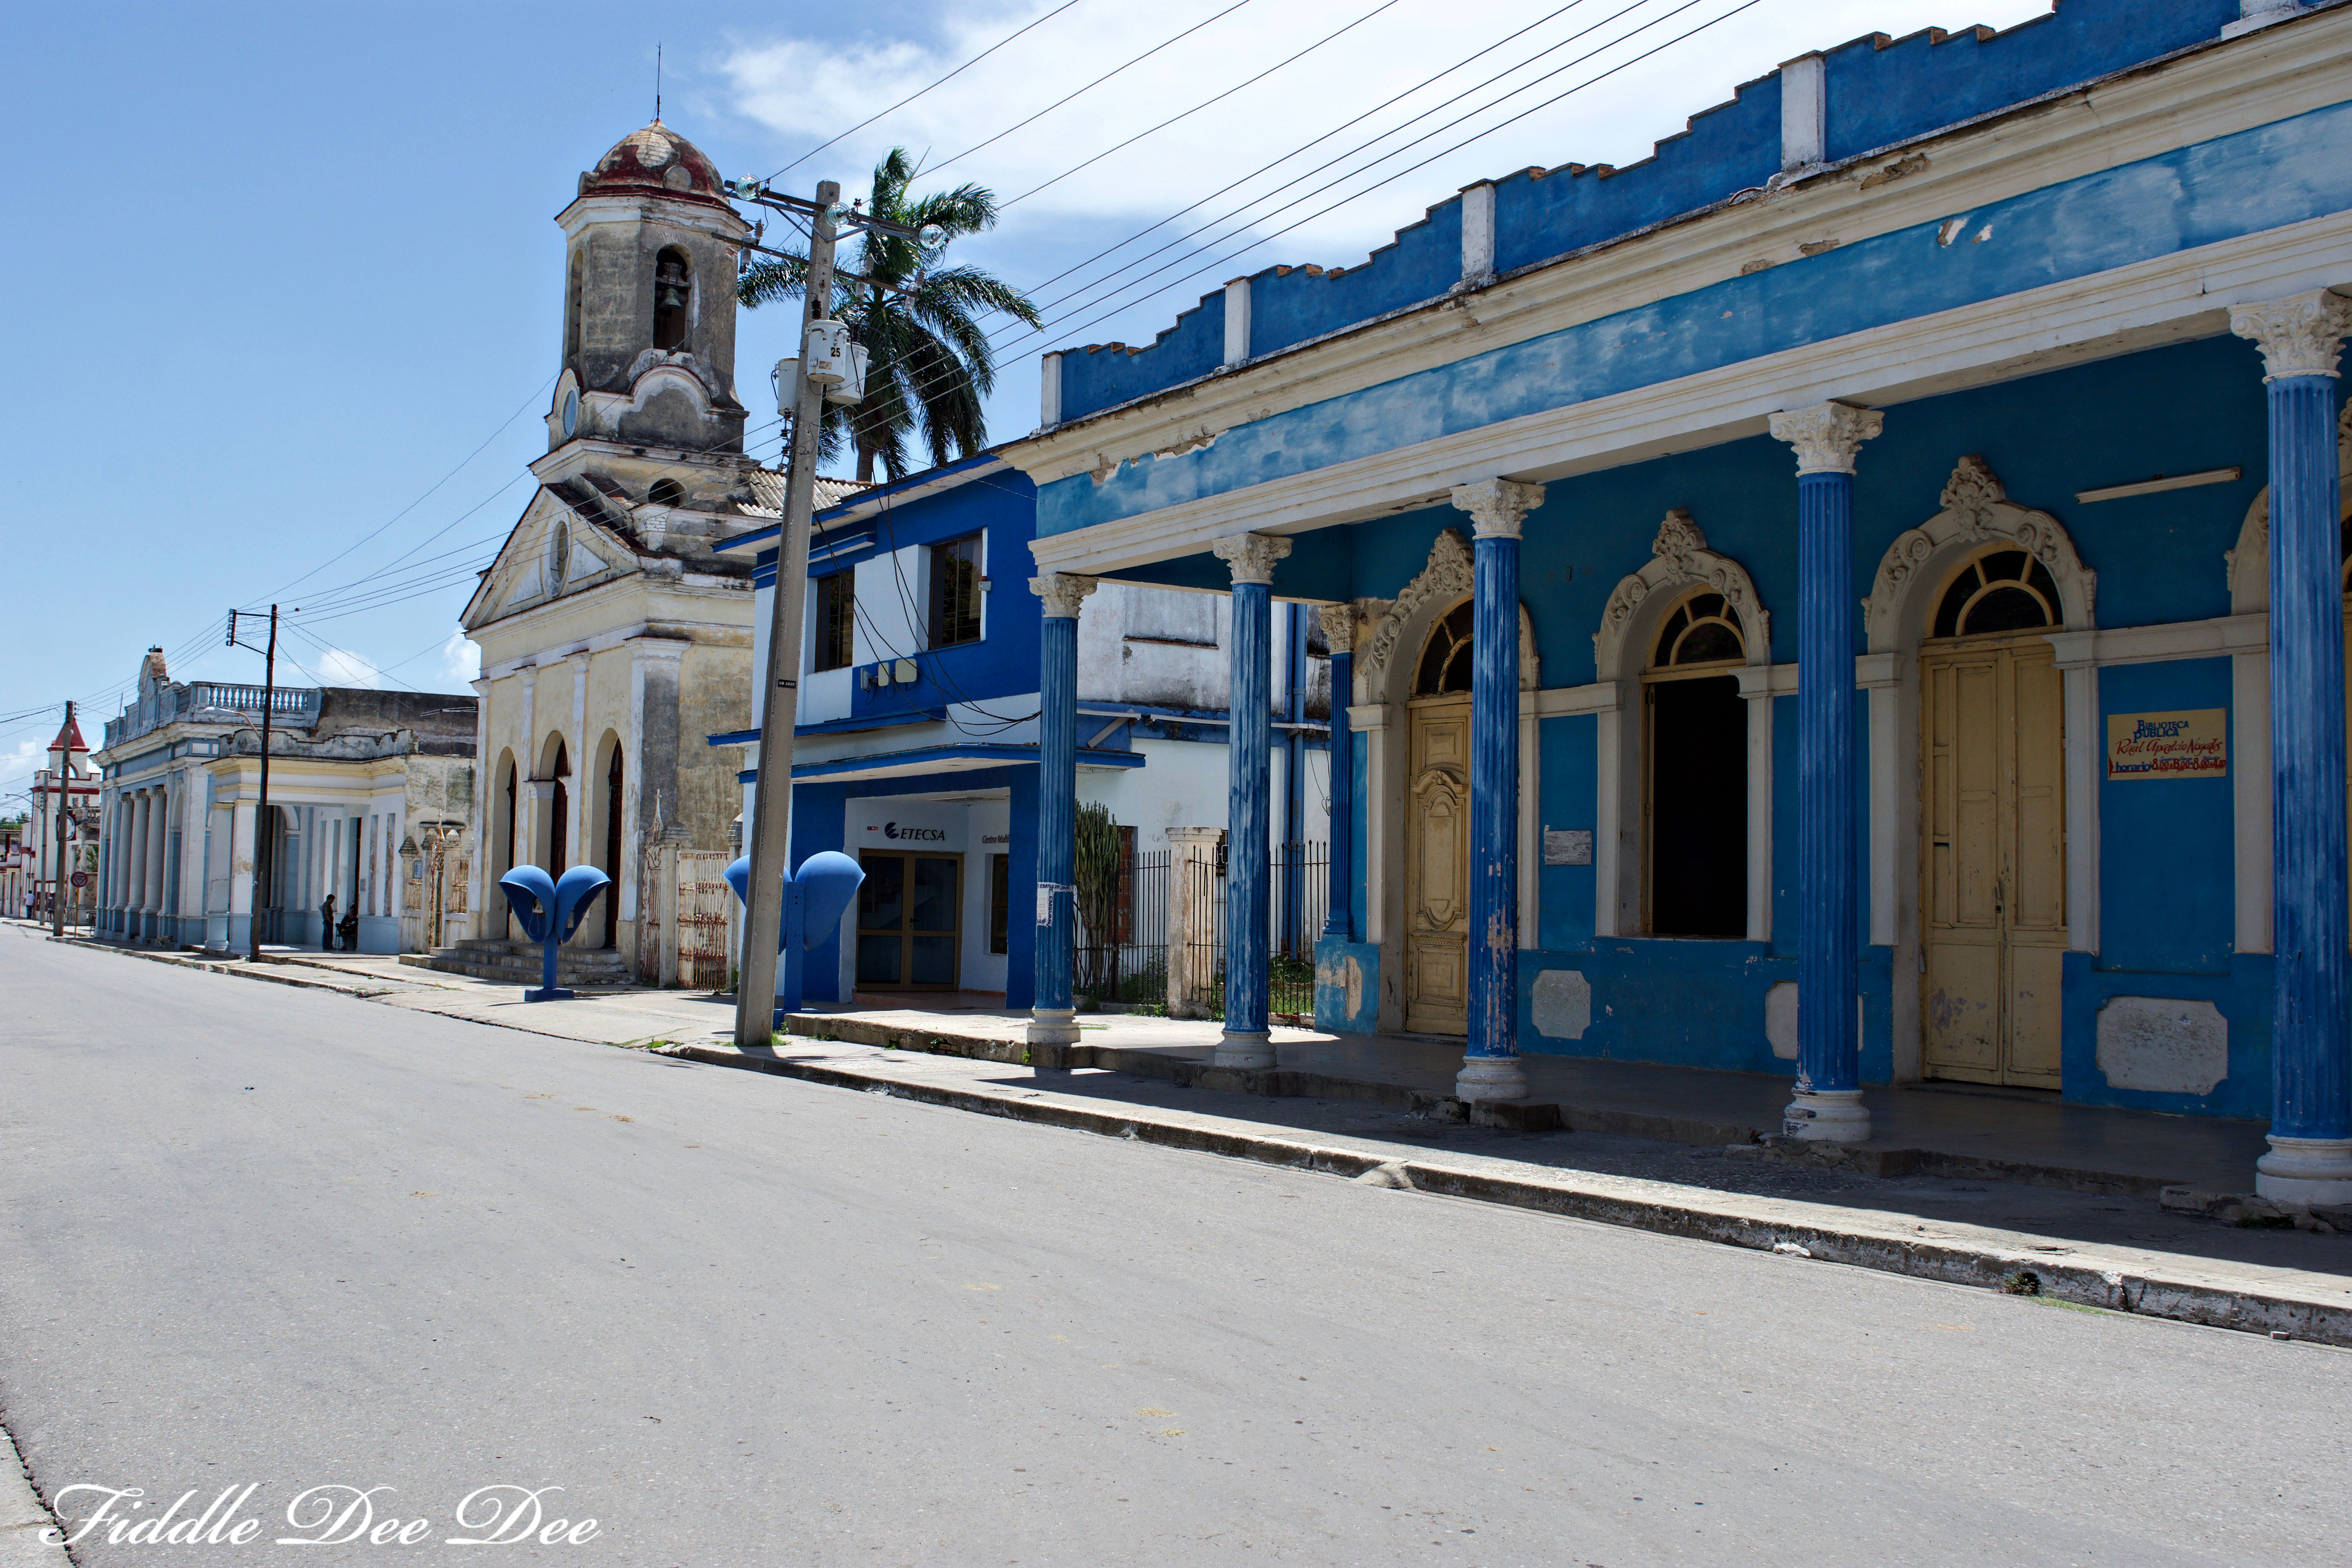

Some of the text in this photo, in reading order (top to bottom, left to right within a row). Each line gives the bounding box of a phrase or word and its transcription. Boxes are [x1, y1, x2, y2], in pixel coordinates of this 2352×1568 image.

[831, 347, 840, 357] 25
[2137, 720, 2189, 731] BIBLIOTECA
[900, 828, 945, 841] ETECSA
[982, 835, 997, 844] Centro
